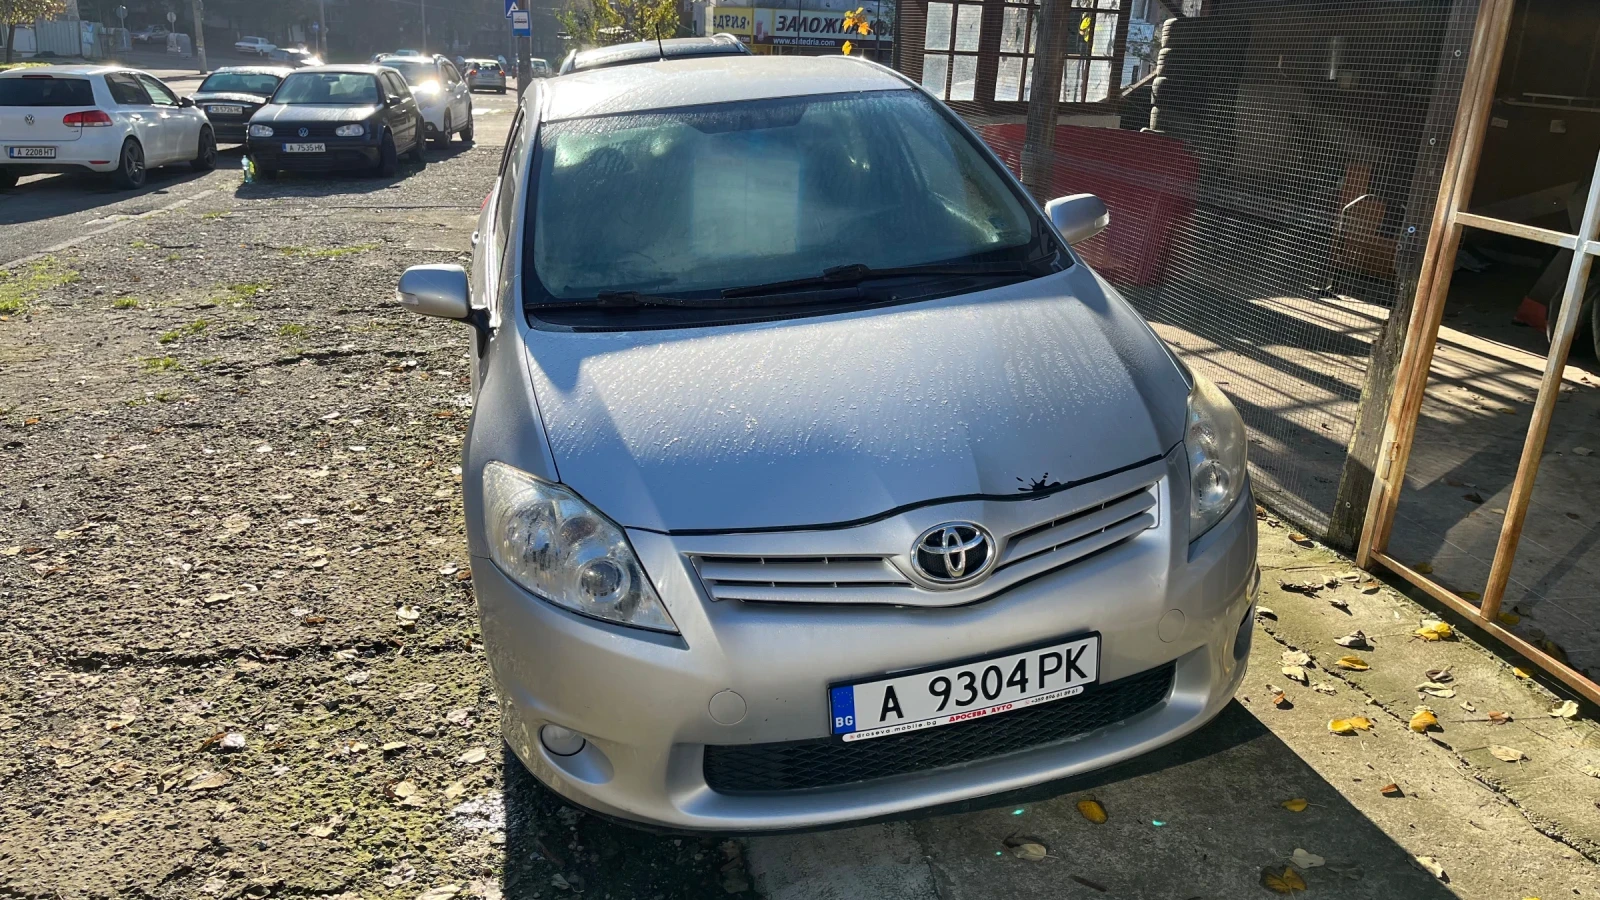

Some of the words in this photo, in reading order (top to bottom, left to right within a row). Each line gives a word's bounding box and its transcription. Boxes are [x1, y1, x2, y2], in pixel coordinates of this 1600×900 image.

[879, 685, 904, 722] A
[928, 658, 1029, 712] 9304
[1038, 644, 1088, 689] PK
[835, 715, 854, 729] BG
